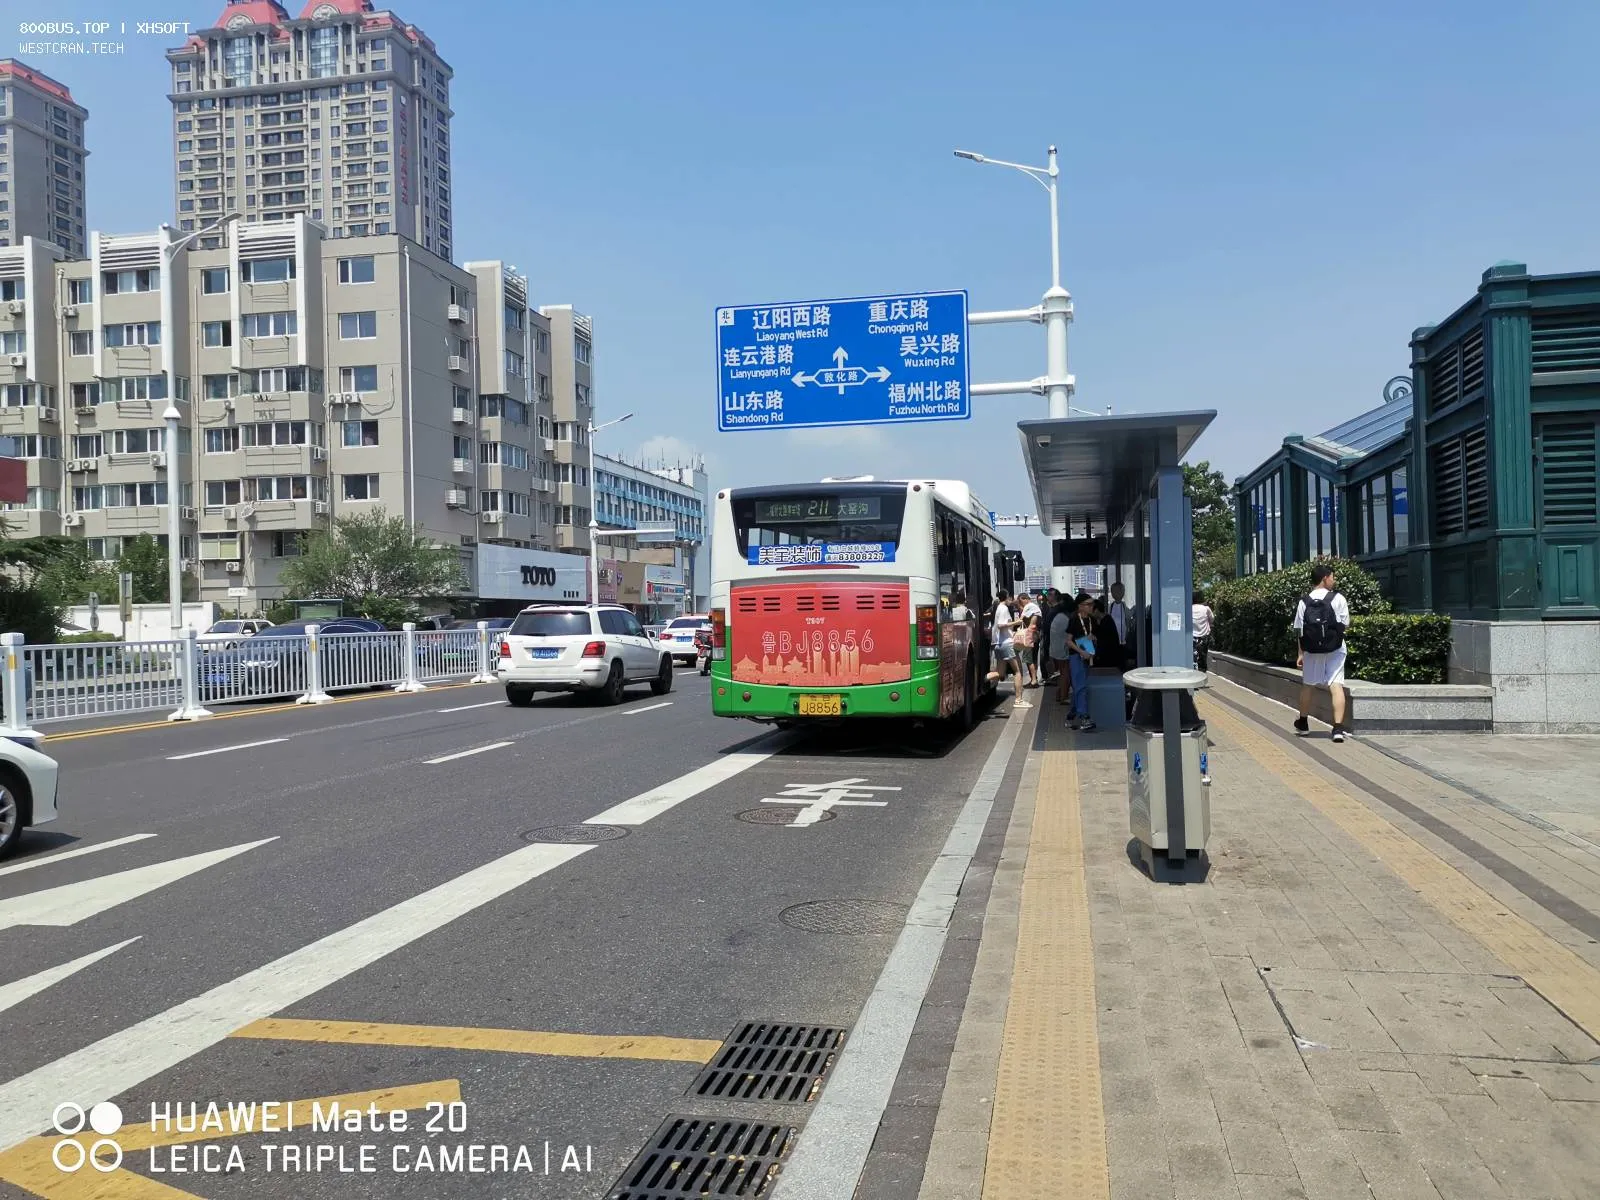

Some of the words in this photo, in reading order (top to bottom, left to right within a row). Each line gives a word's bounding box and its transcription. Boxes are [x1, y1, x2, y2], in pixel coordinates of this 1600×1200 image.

[753, 305, 832, 329] 辽阳西路
[868, 298, 929, 323] 重庆路
[756, 331, 795, 343] Liaoyang
[795, 330, 816, 339] West
[817, 328, 828, 338] Rd
[868, 323, 914, 335] Chongqing
[915, 321, 928, 331] Rd
[900, 334, 961, 356] 吴兴路
[723, 343, 794, 367] 连云港路
[904, 356, 940, 368] Wuxing
[941, 356, 955, 366] Rd
[730, 368, 779, 380] Lianyungang
[780, 366, 791, 376] Rd
[824, 371, 858, 382] 敦化路
[888, 380, 962, 403] 福州北路
[725, 390, 784, 412] 山东路
[889, 404, 921, 415] Fuzhou
[921, 403, 947, 414] North
[947, 402, 960, 412] Rd
[726, 412, 769, 425] Shandong
[771, 412, 784, 421] Rd
[807, 500, 829, 516] 211
[520, 565, 556, 586] TOTO
[762, 629, 875, 654] 鲁BJ8856
[801, 701, 839, 714] J8856
